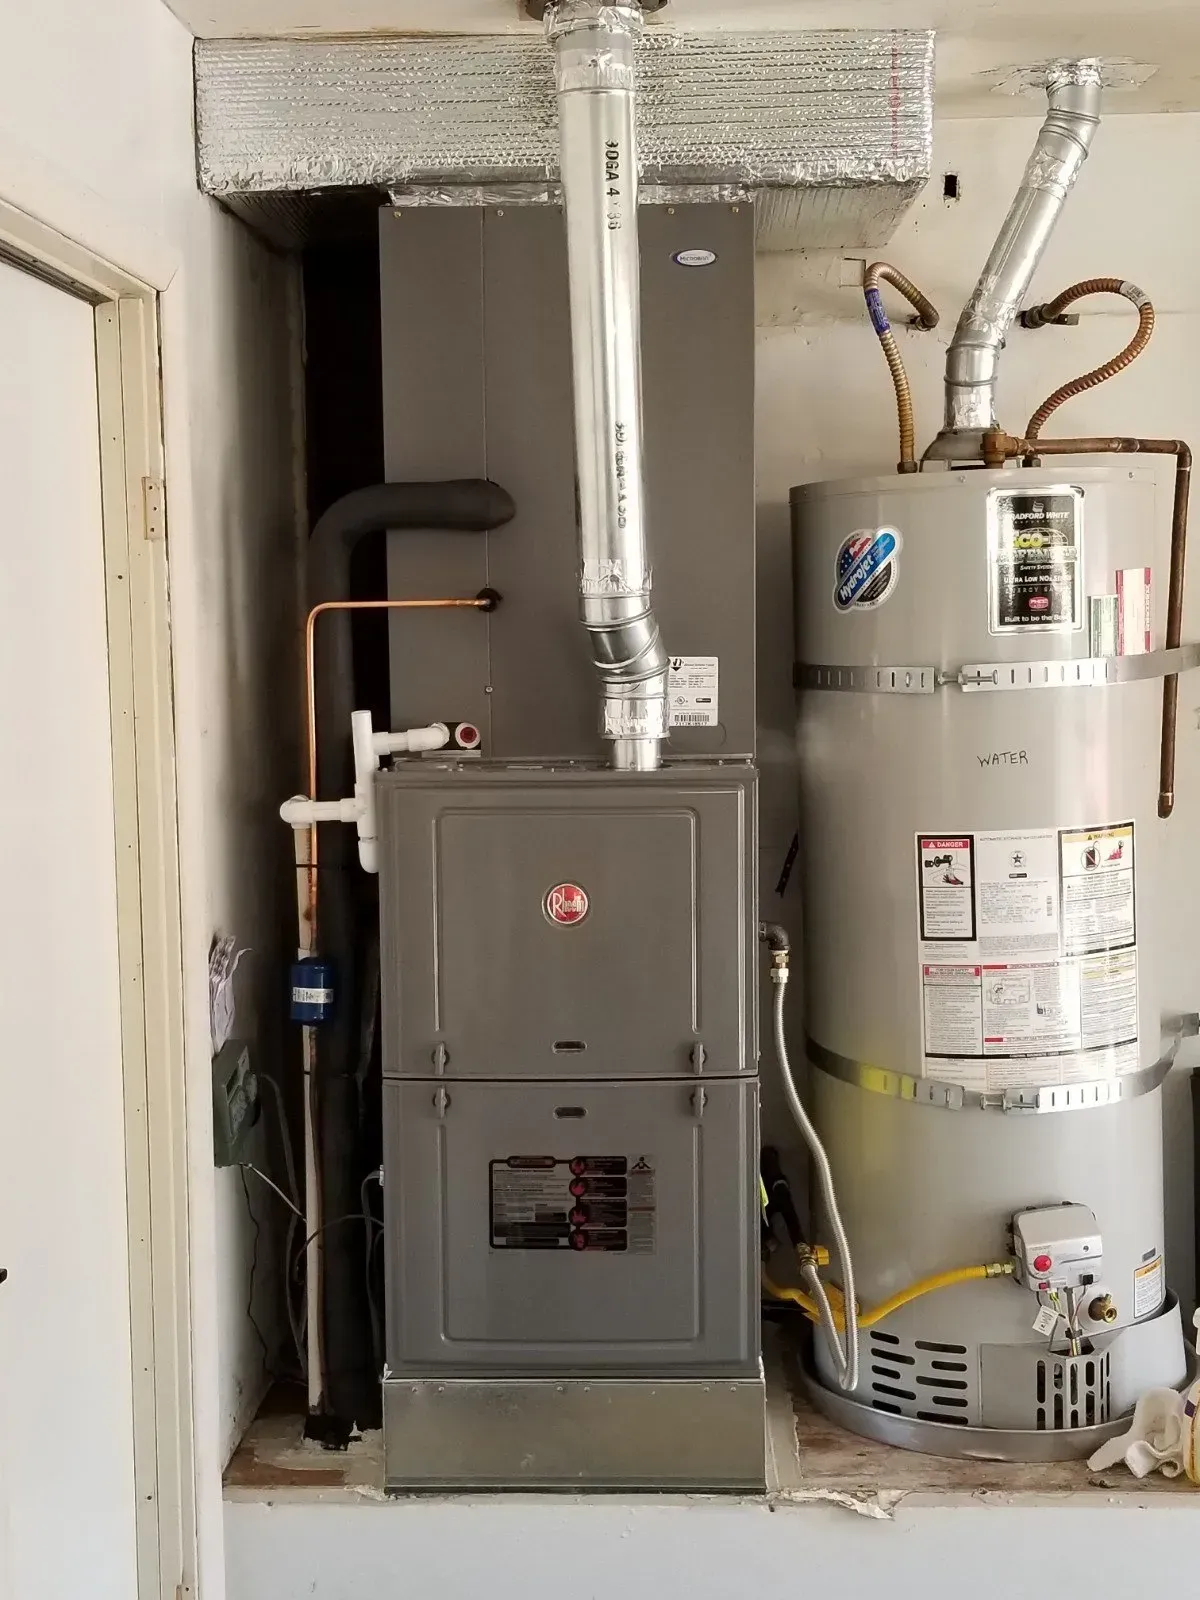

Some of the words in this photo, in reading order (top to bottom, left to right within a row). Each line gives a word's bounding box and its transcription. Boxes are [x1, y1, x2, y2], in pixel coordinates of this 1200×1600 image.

[1046, 511, 1070, 519] WHITE
[976, 749, 1028, 768] WATER
[552, 887, 585, 918] Rheem
